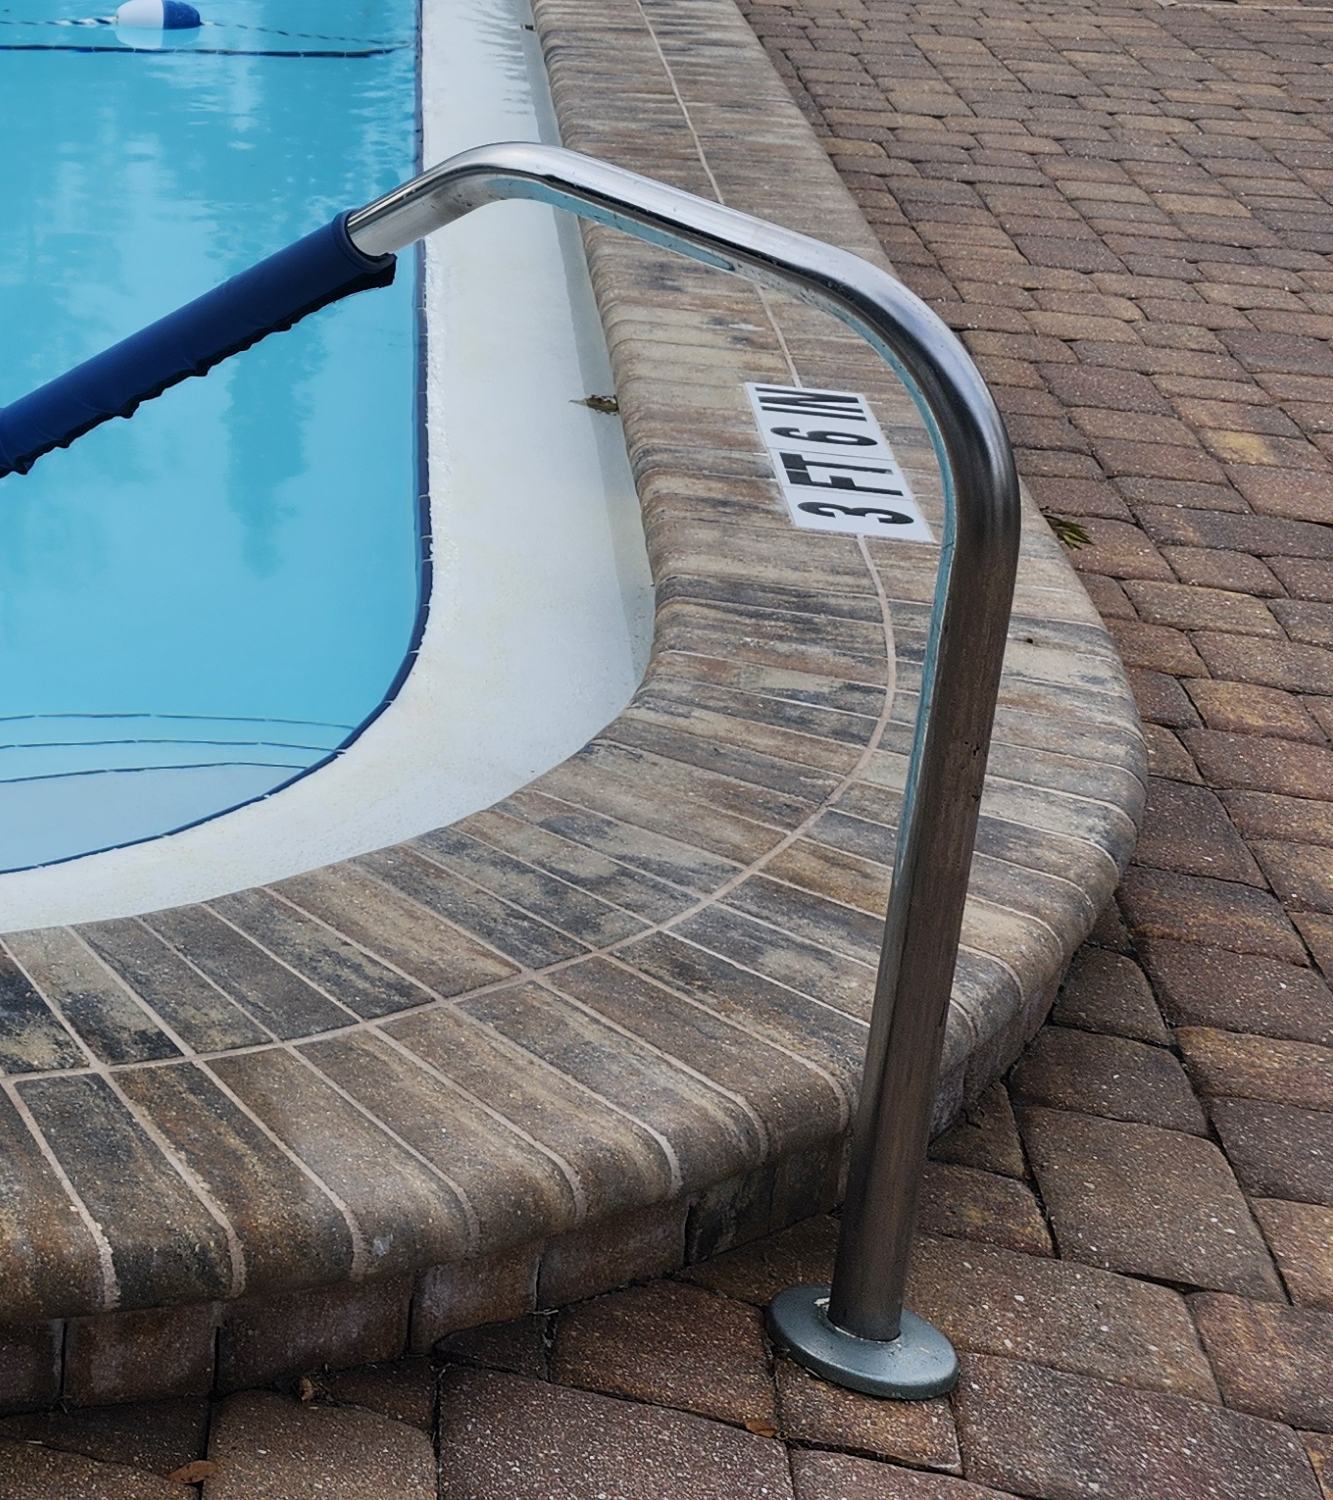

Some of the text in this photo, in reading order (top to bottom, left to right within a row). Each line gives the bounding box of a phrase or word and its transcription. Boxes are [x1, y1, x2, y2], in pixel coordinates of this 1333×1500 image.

[755, 387, 914, 525] 3 FT 6 IN
